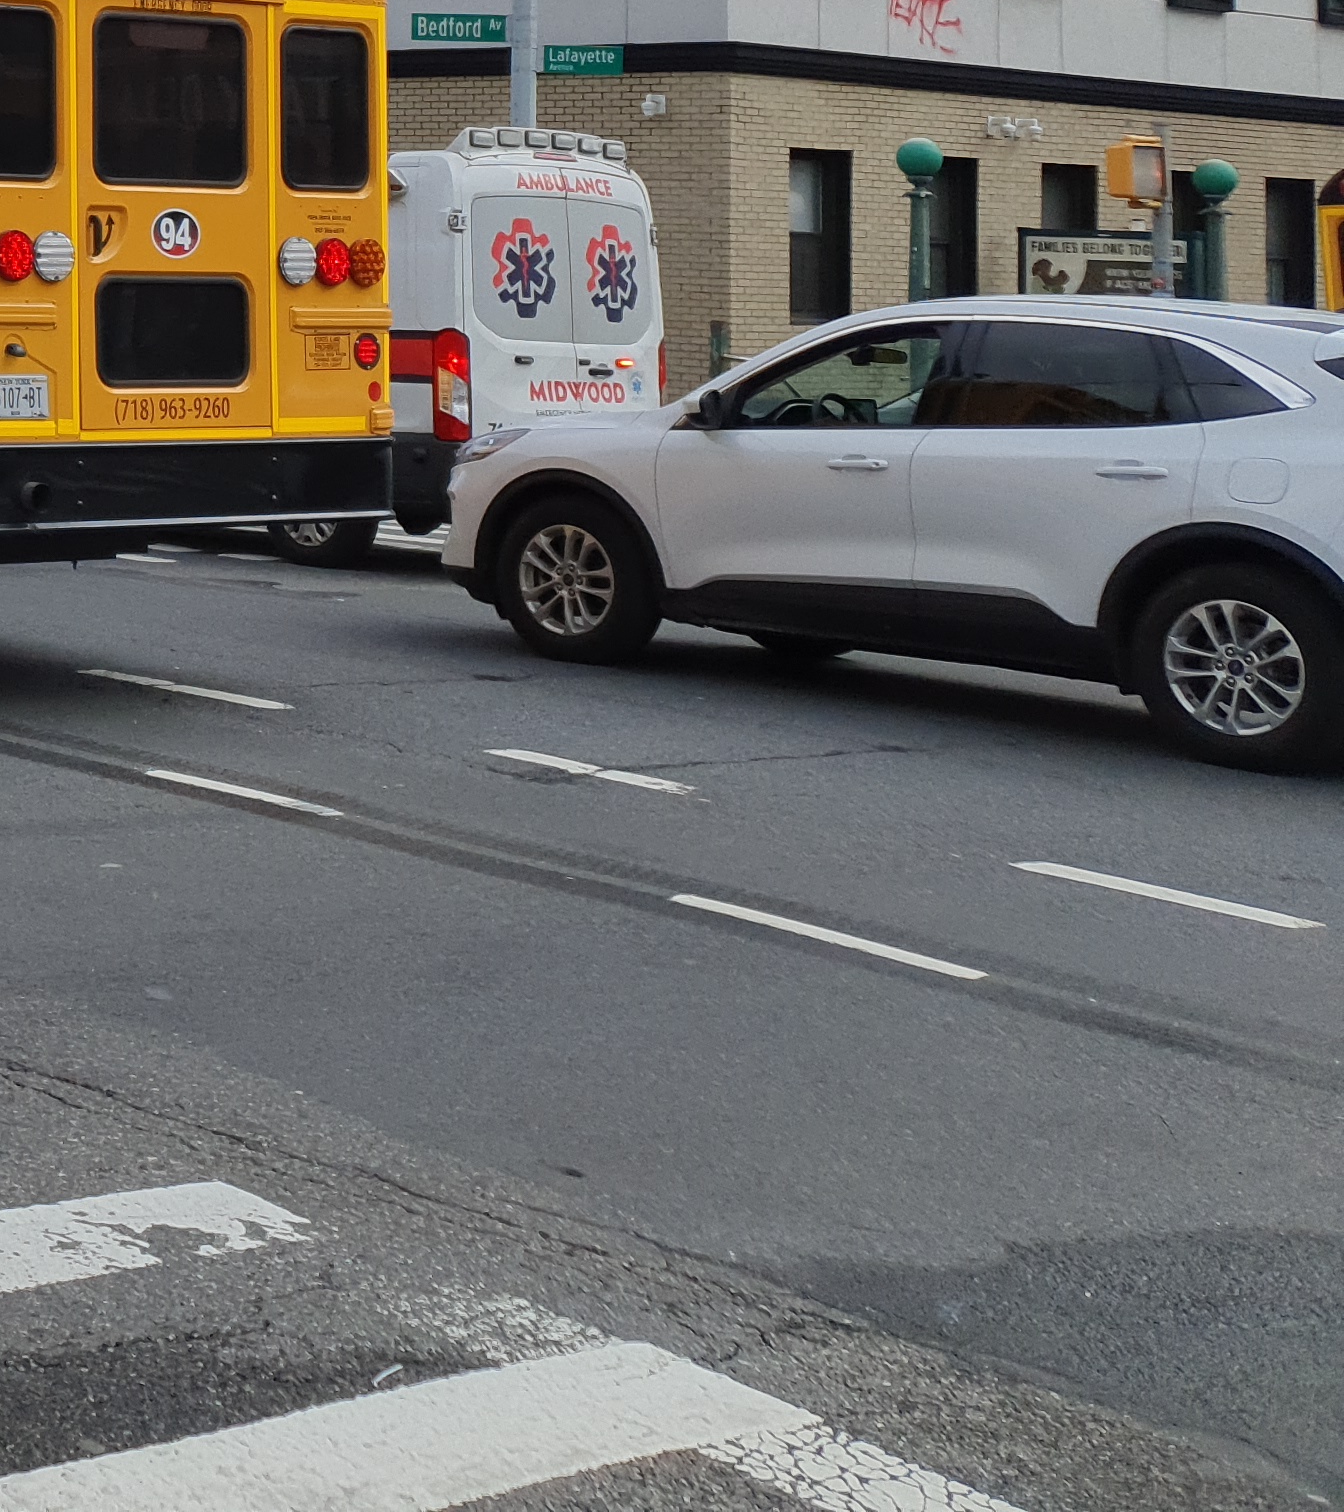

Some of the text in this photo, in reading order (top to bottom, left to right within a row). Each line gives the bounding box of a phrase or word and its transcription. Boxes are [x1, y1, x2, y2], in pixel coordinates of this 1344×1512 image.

[417, 16, 502, 38] Bedford Av
[548, 47, 615, 66] Lafayette
[516, 172, 614, 198] AMBULANCE
[159, 217, 192, 251] 94
[1031, 240, 1078, 254] FAMILIES
[1082, 241, 1125, 256] BELONG
[529, 380, 627, 404] MIDWOOD
[113, 396, 231, 425] (718) 963-9260
